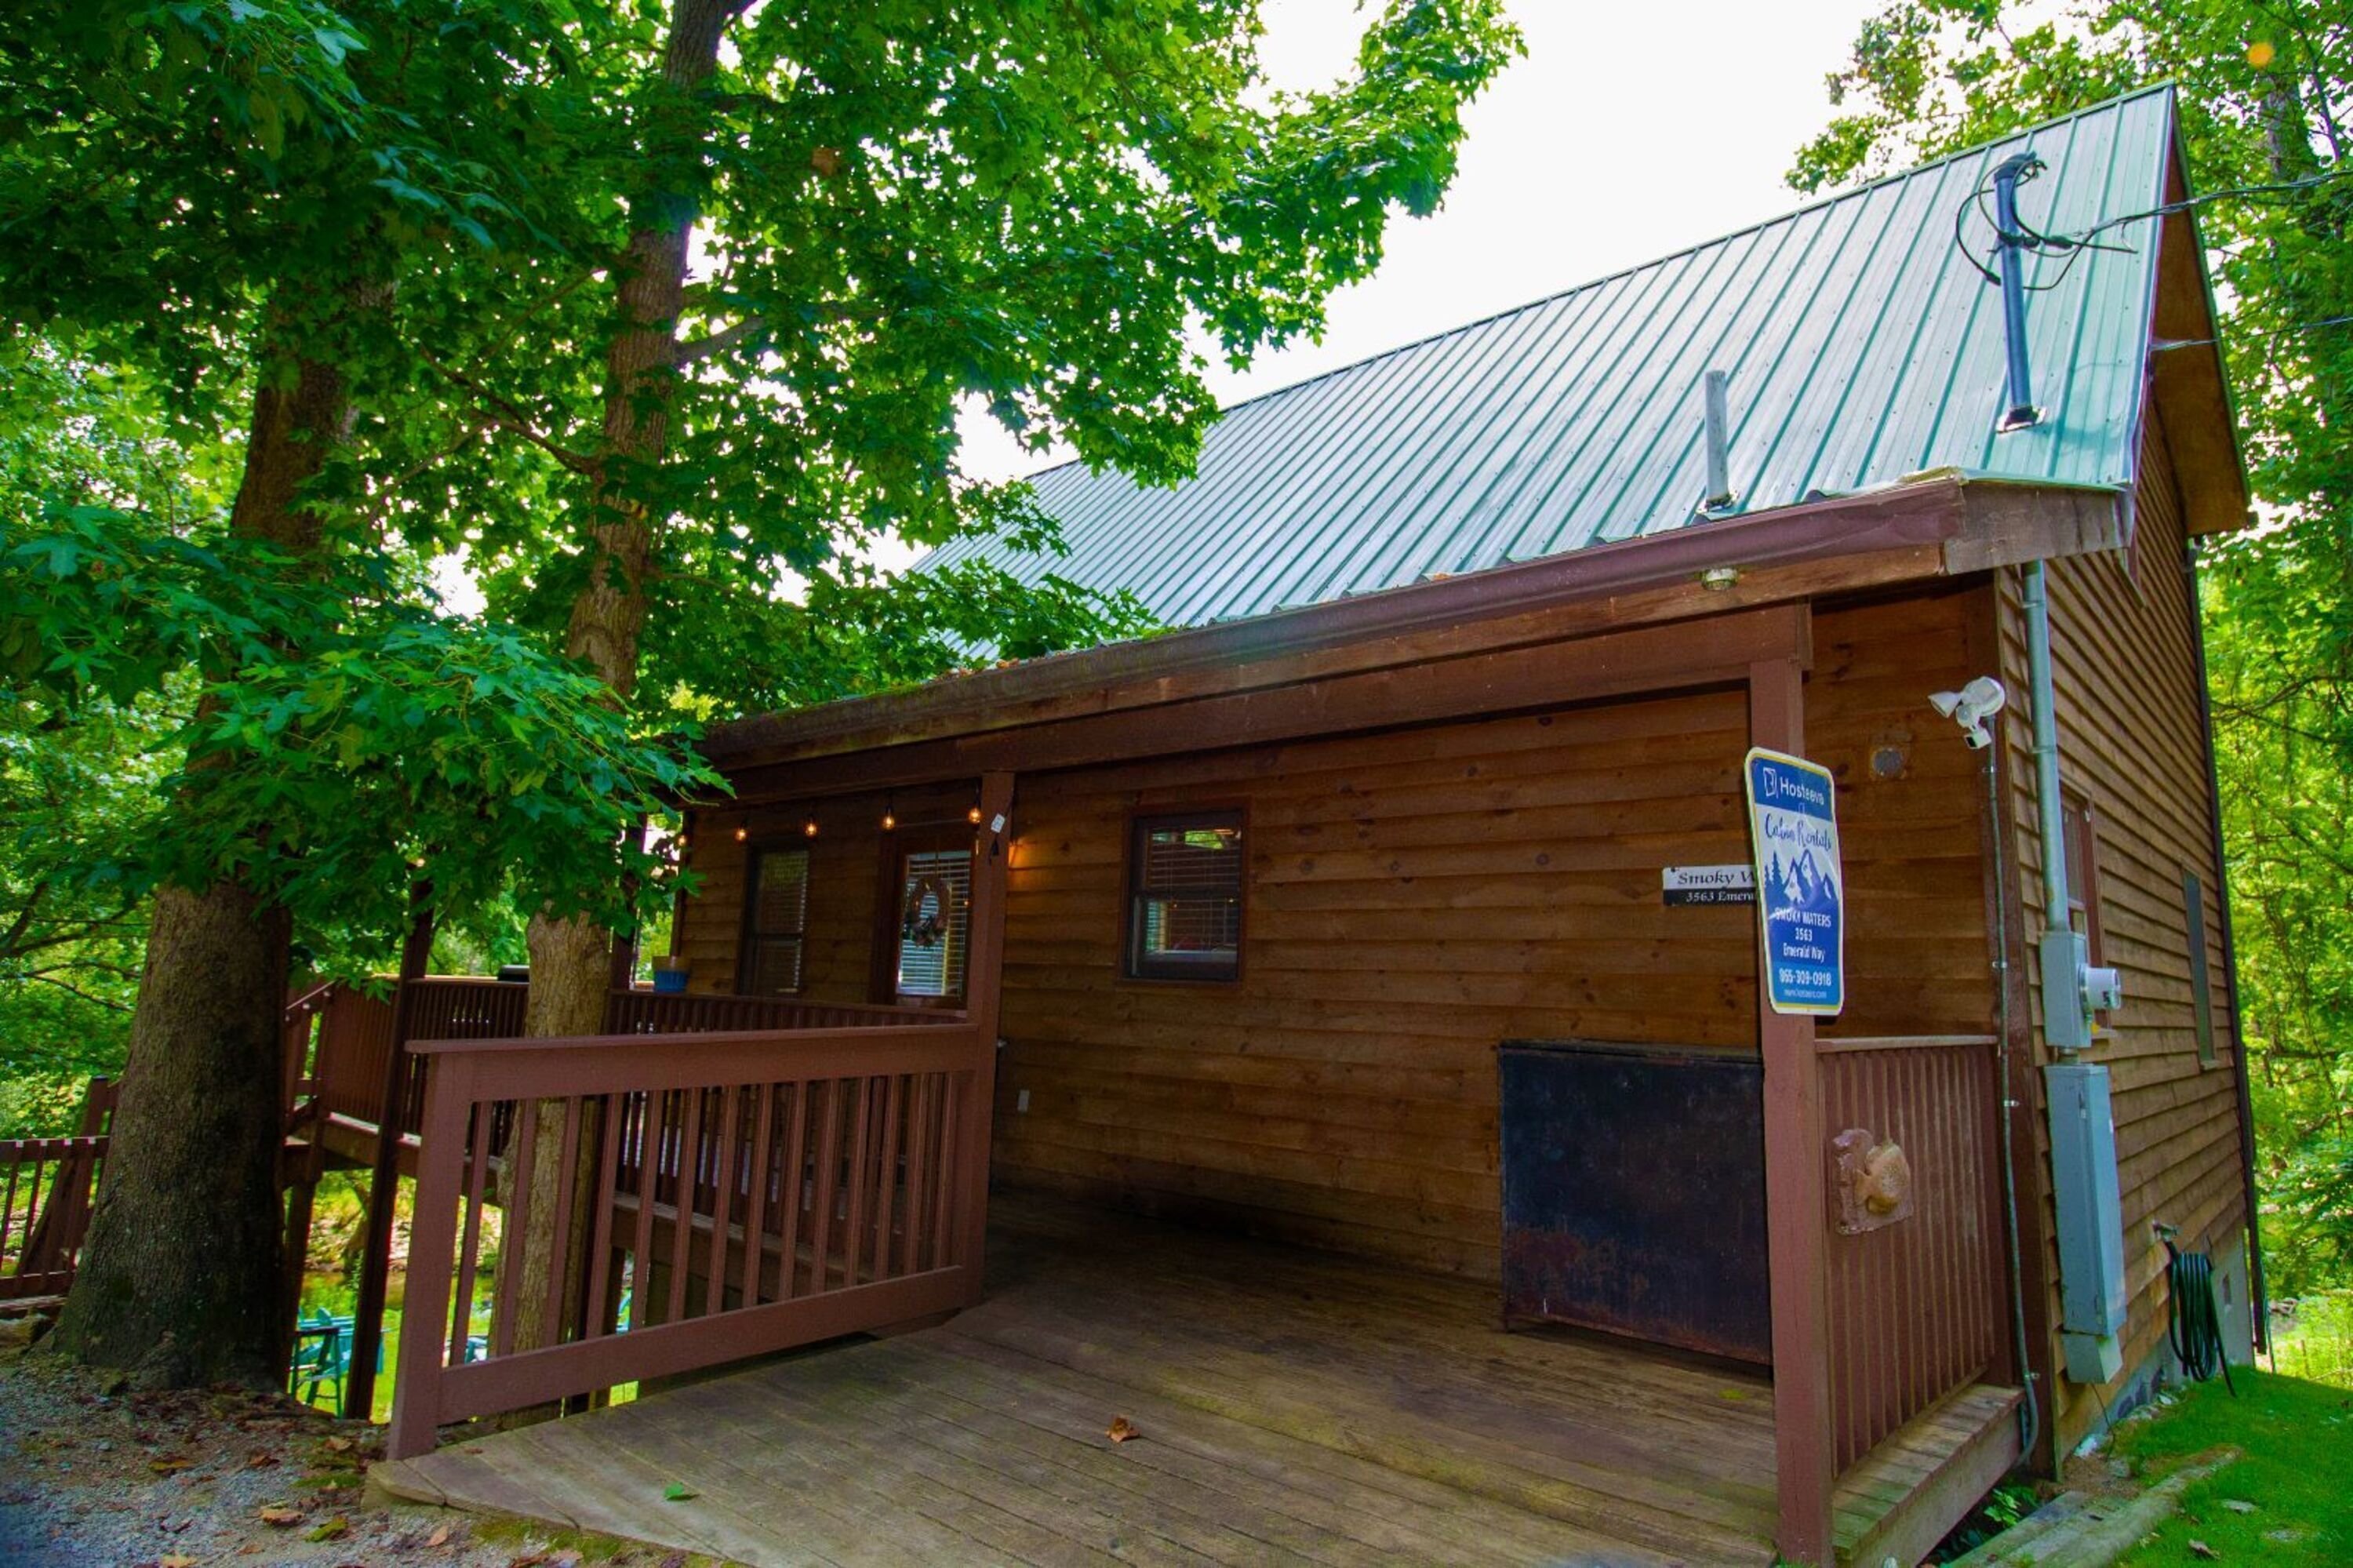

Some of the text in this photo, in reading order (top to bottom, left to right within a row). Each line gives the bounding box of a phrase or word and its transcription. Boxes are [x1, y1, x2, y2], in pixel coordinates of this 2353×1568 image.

[1765, 813, 1832, 852] Cabin Rentals
[1678, 870, 1734, 885] Smoky
[1686, 892, 1715, 903] 3563
[1802, 911, 1832, 928] WATERS
[1795, 927, 1813, 941] 3563
[1783, 942, 1825, 963] Emerald Way
